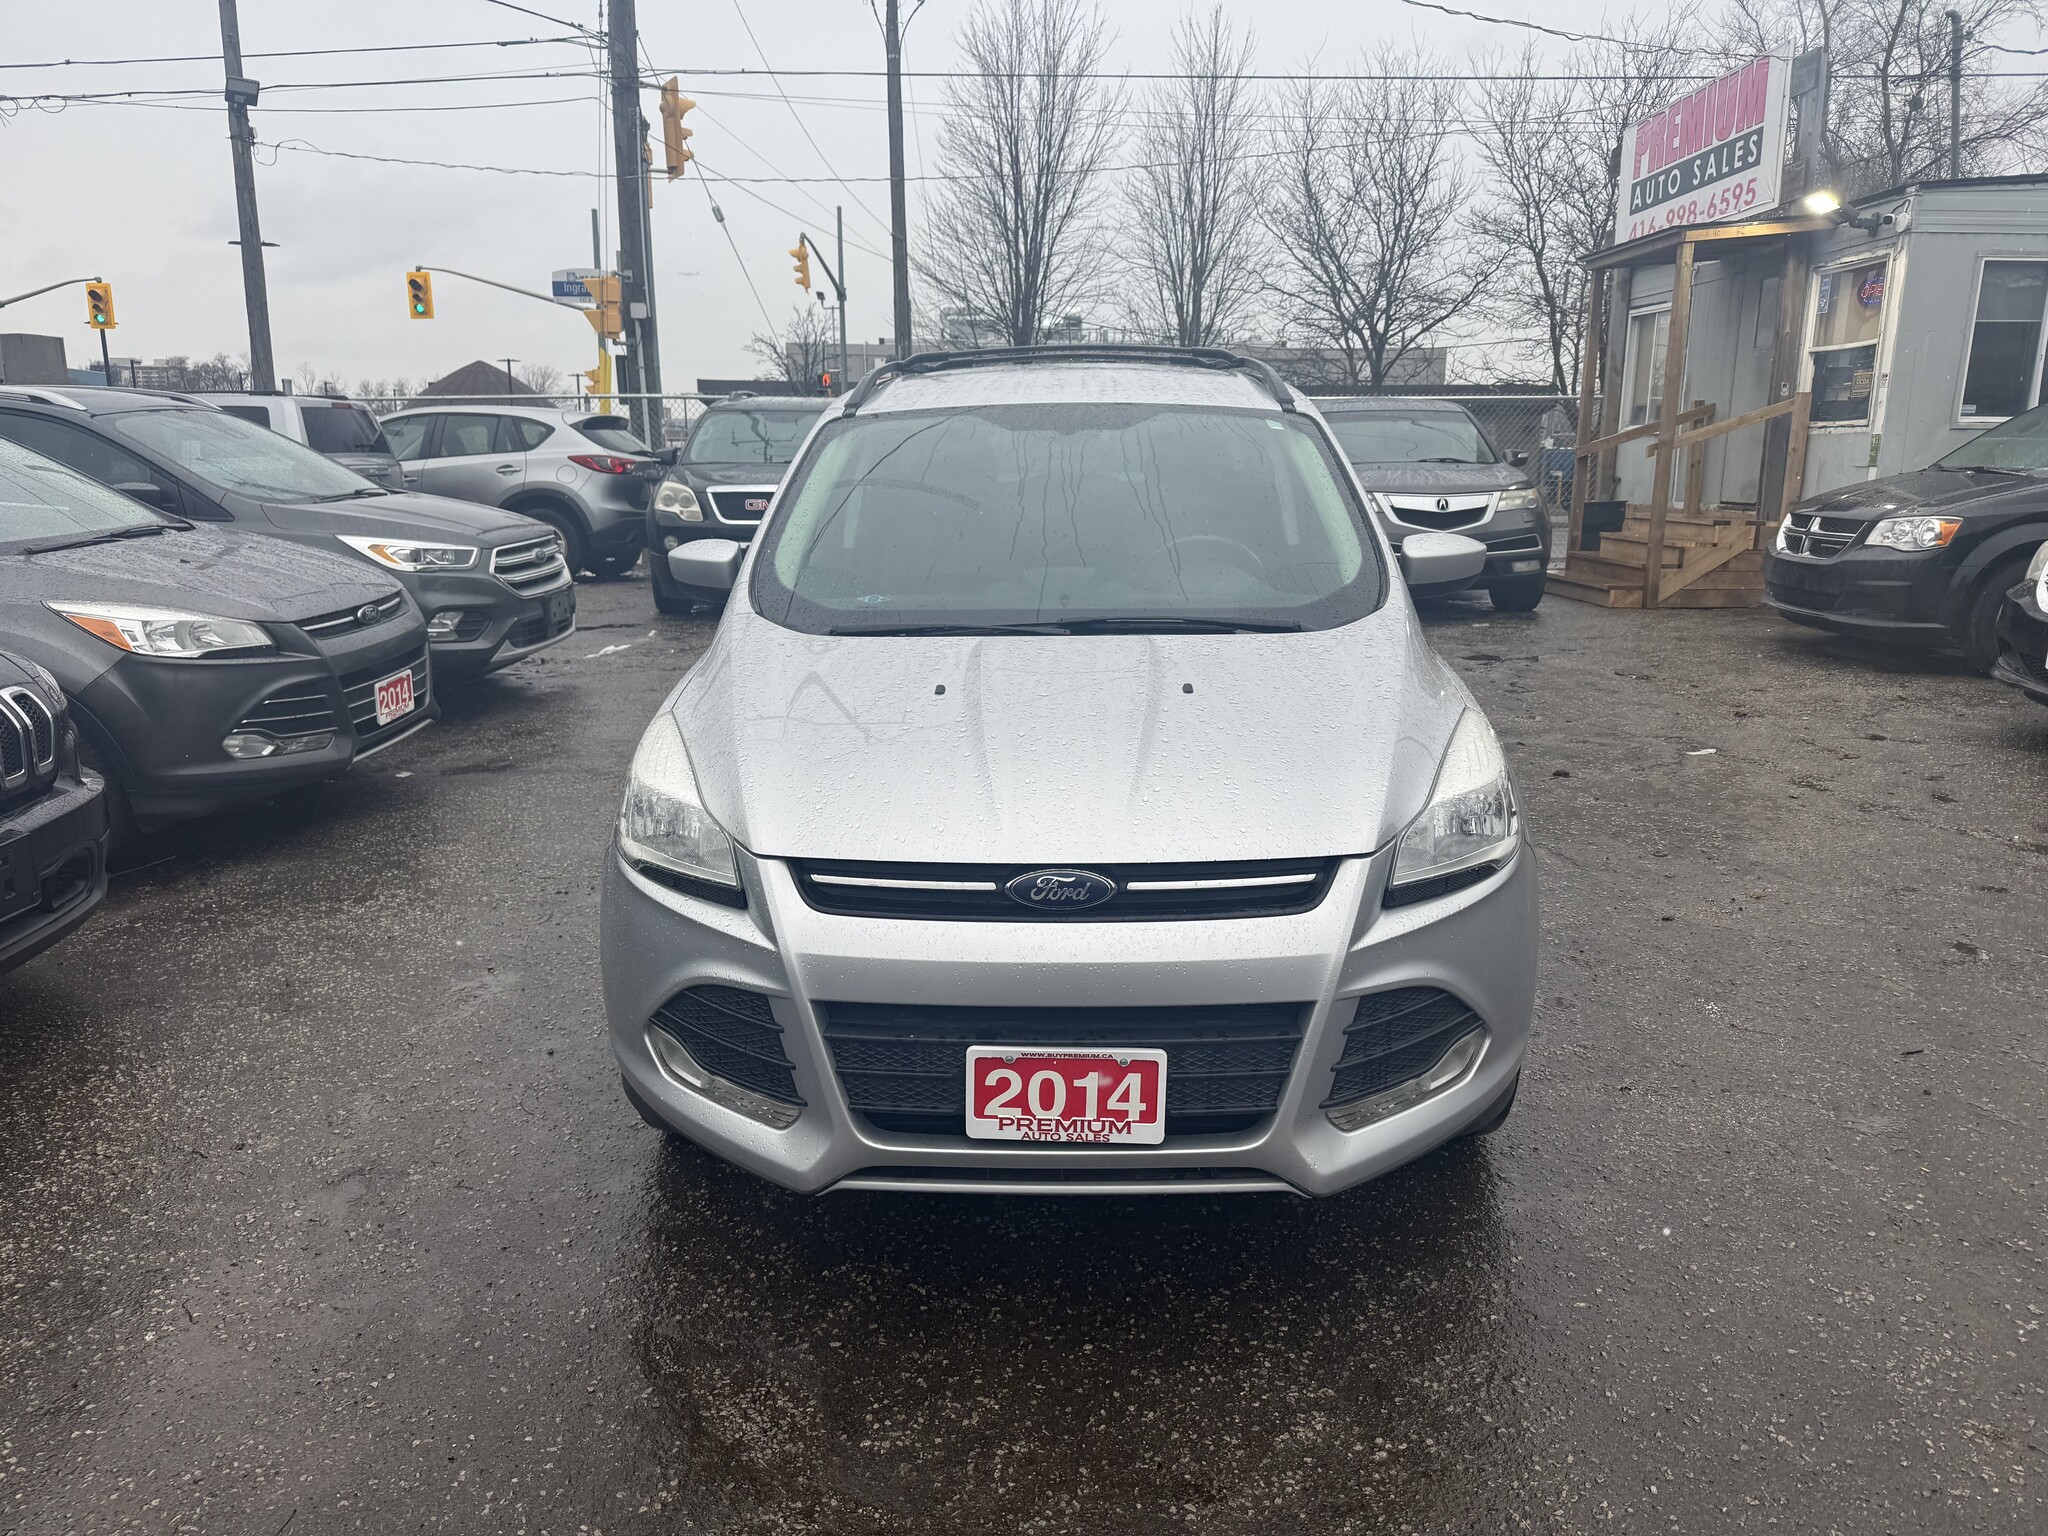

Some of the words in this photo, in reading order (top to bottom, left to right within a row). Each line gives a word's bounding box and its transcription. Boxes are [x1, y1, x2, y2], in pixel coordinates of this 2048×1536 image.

[1633, 56, 1770, 181] PREMIUM
[1632, 169, 1681, 210] AUTO
[1692, 134, 1758, 186] SALES
[1629, 177, 1757, 240] 416-998-6595
[564, 283, 590, 295] Ingra
[1861, 283, 1885, 298] OPE
[380, 680, 410, 714] 2014
[1030, 875, 1092, 901] Ford
[1020, 1052, 1114, 1060] WWW.BUYPREMIUM.CA
[983, 1068, 1147, 1121] 2014
[997, 1116, 1133, 1135] PREMIUM
[1021, 1131, 1061, 1142] AUTO
[1065, 1132, 1111, 1143] SALES
